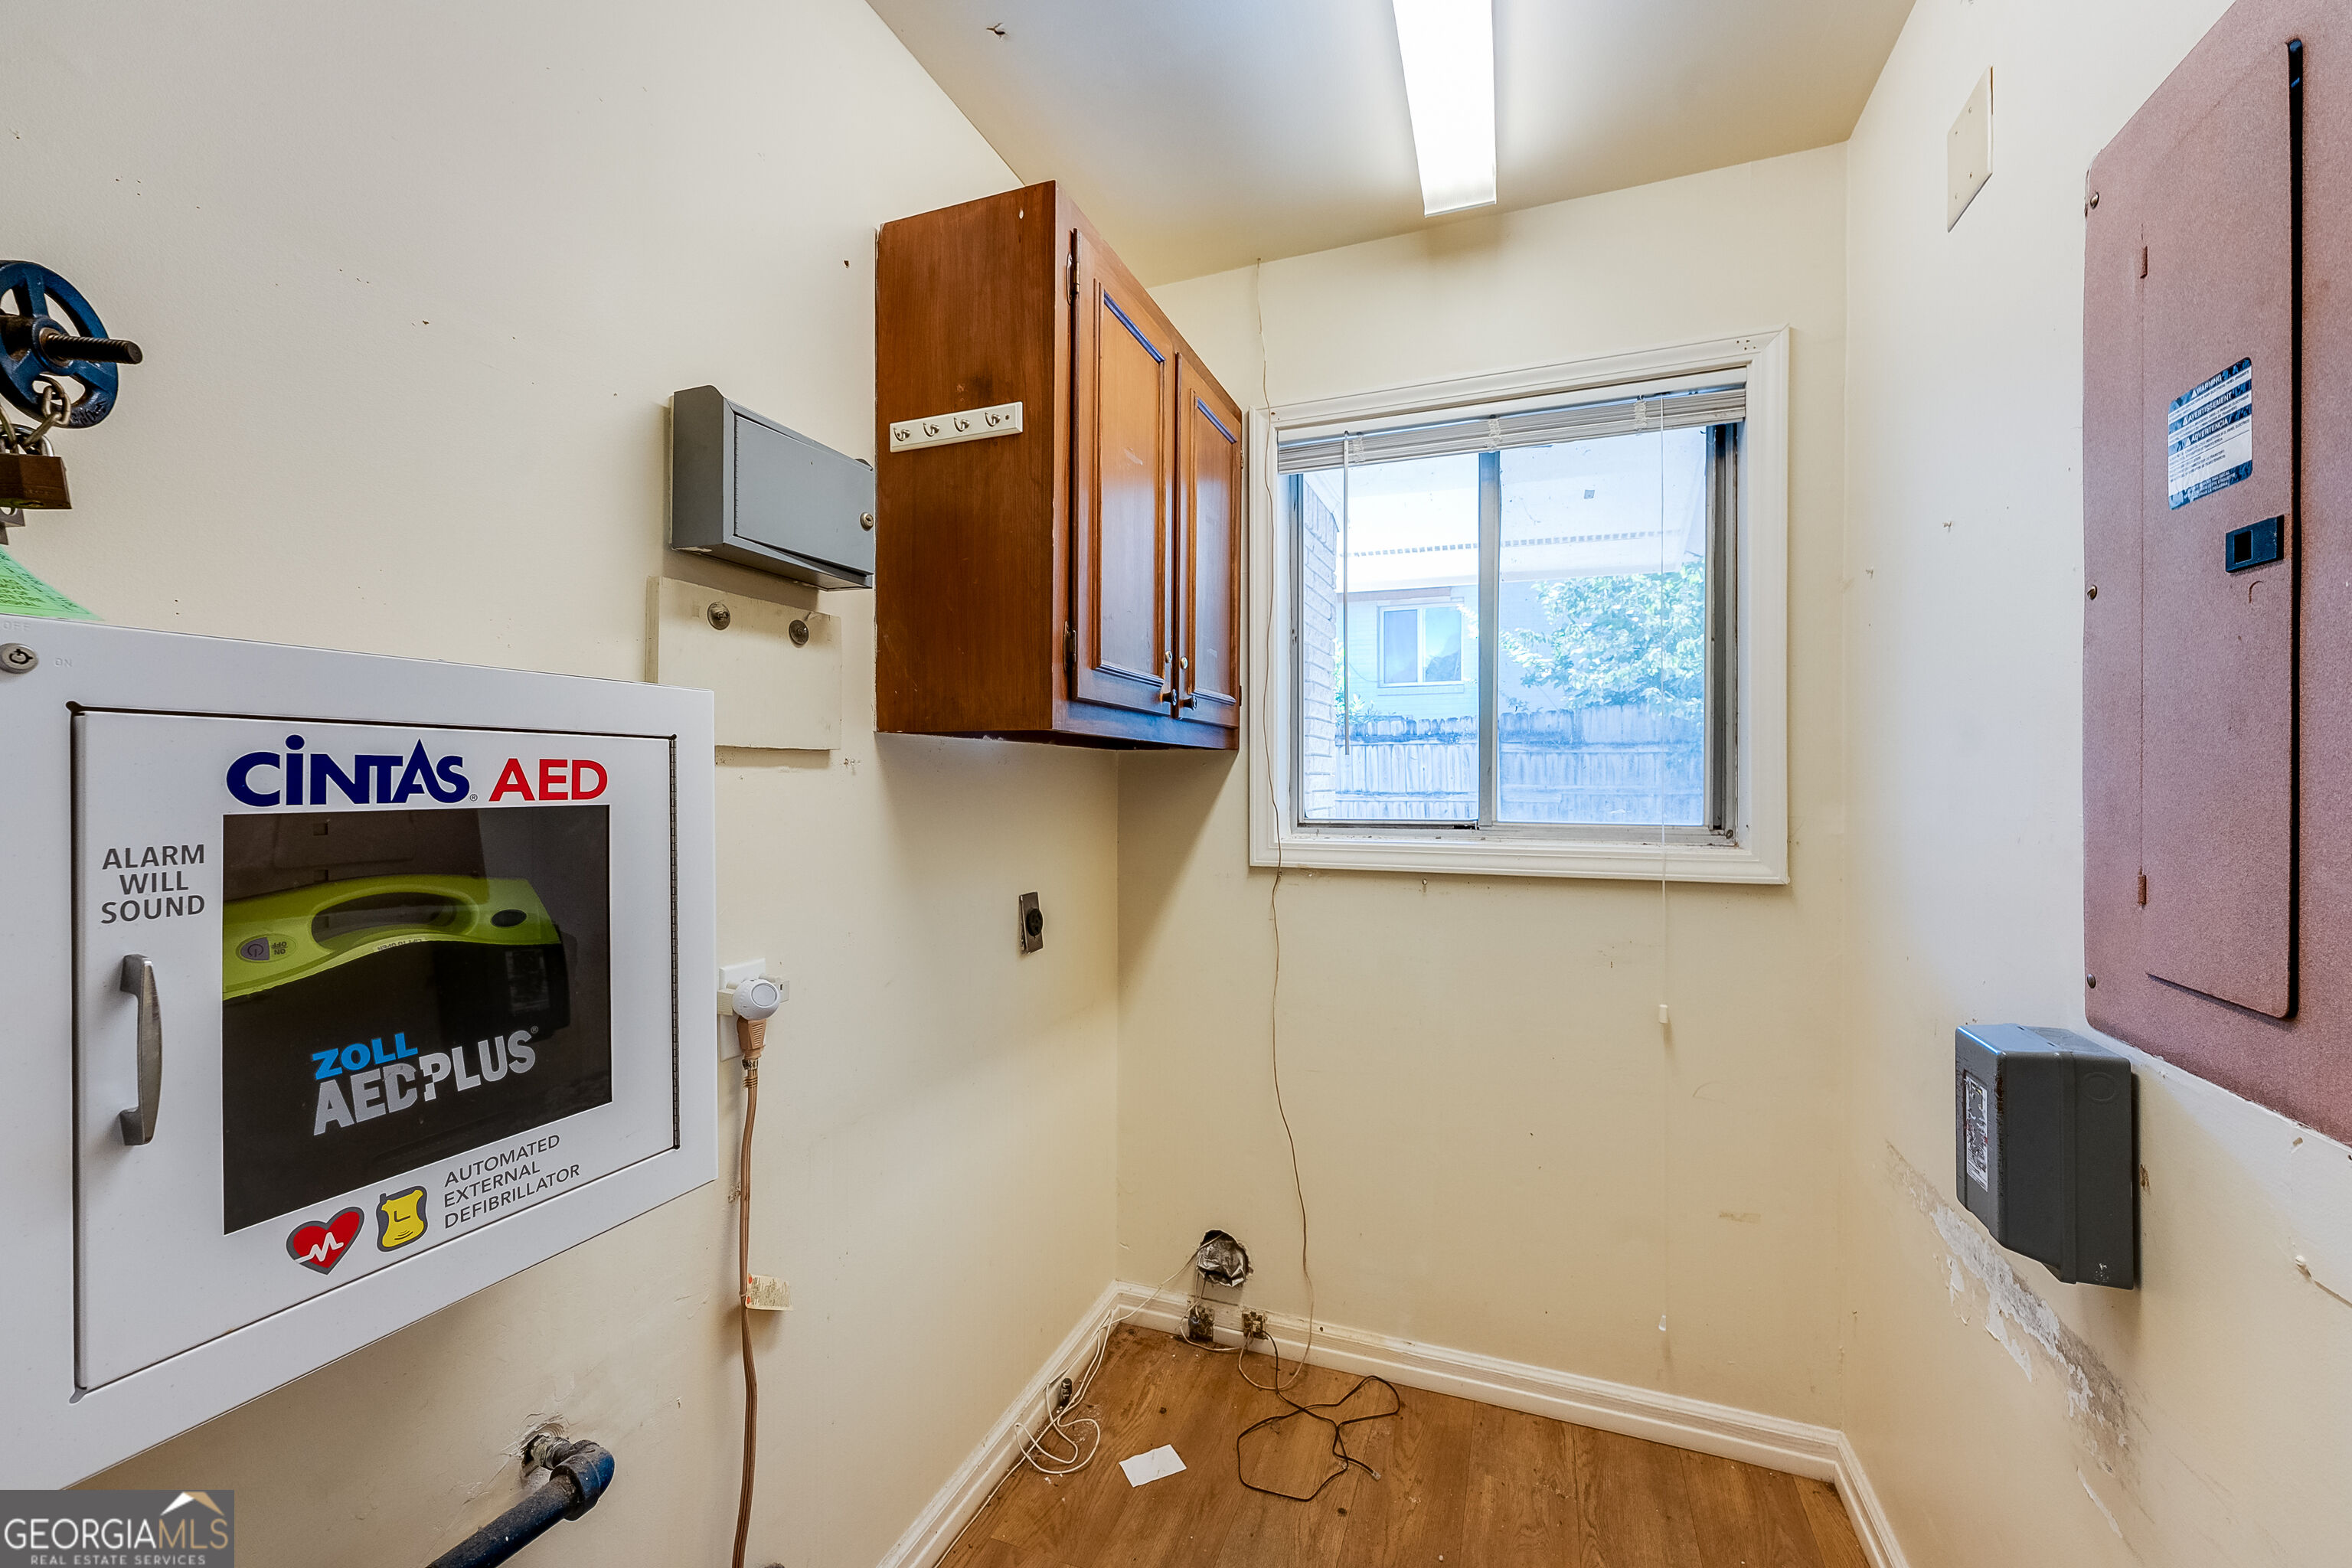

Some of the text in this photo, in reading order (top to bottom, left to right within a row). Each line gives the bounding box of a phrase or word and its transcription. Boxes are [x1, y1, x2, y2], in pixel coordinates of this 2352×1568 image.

[2196, 374, 2223, 394] WARNING
[2187, 391, 2233, 422] AVERTISSEMENT
[2191, 416, 2229, 443] ADVERTENCIA
[488, 758, 608, 802] AED
[102, 844, 204, 870] ALARM
[119, 871, 189, 895] WILL
[100, 895, 204, 924] SOUND
[312, 1031, 419, 1080] ZOLL
[444, 1134, 560, 1187] AUTOMATED
[443, 1161, 541, 1208] EXTERNAL
[444, 1164, 580, 1229] DEFIBRILLATOR
